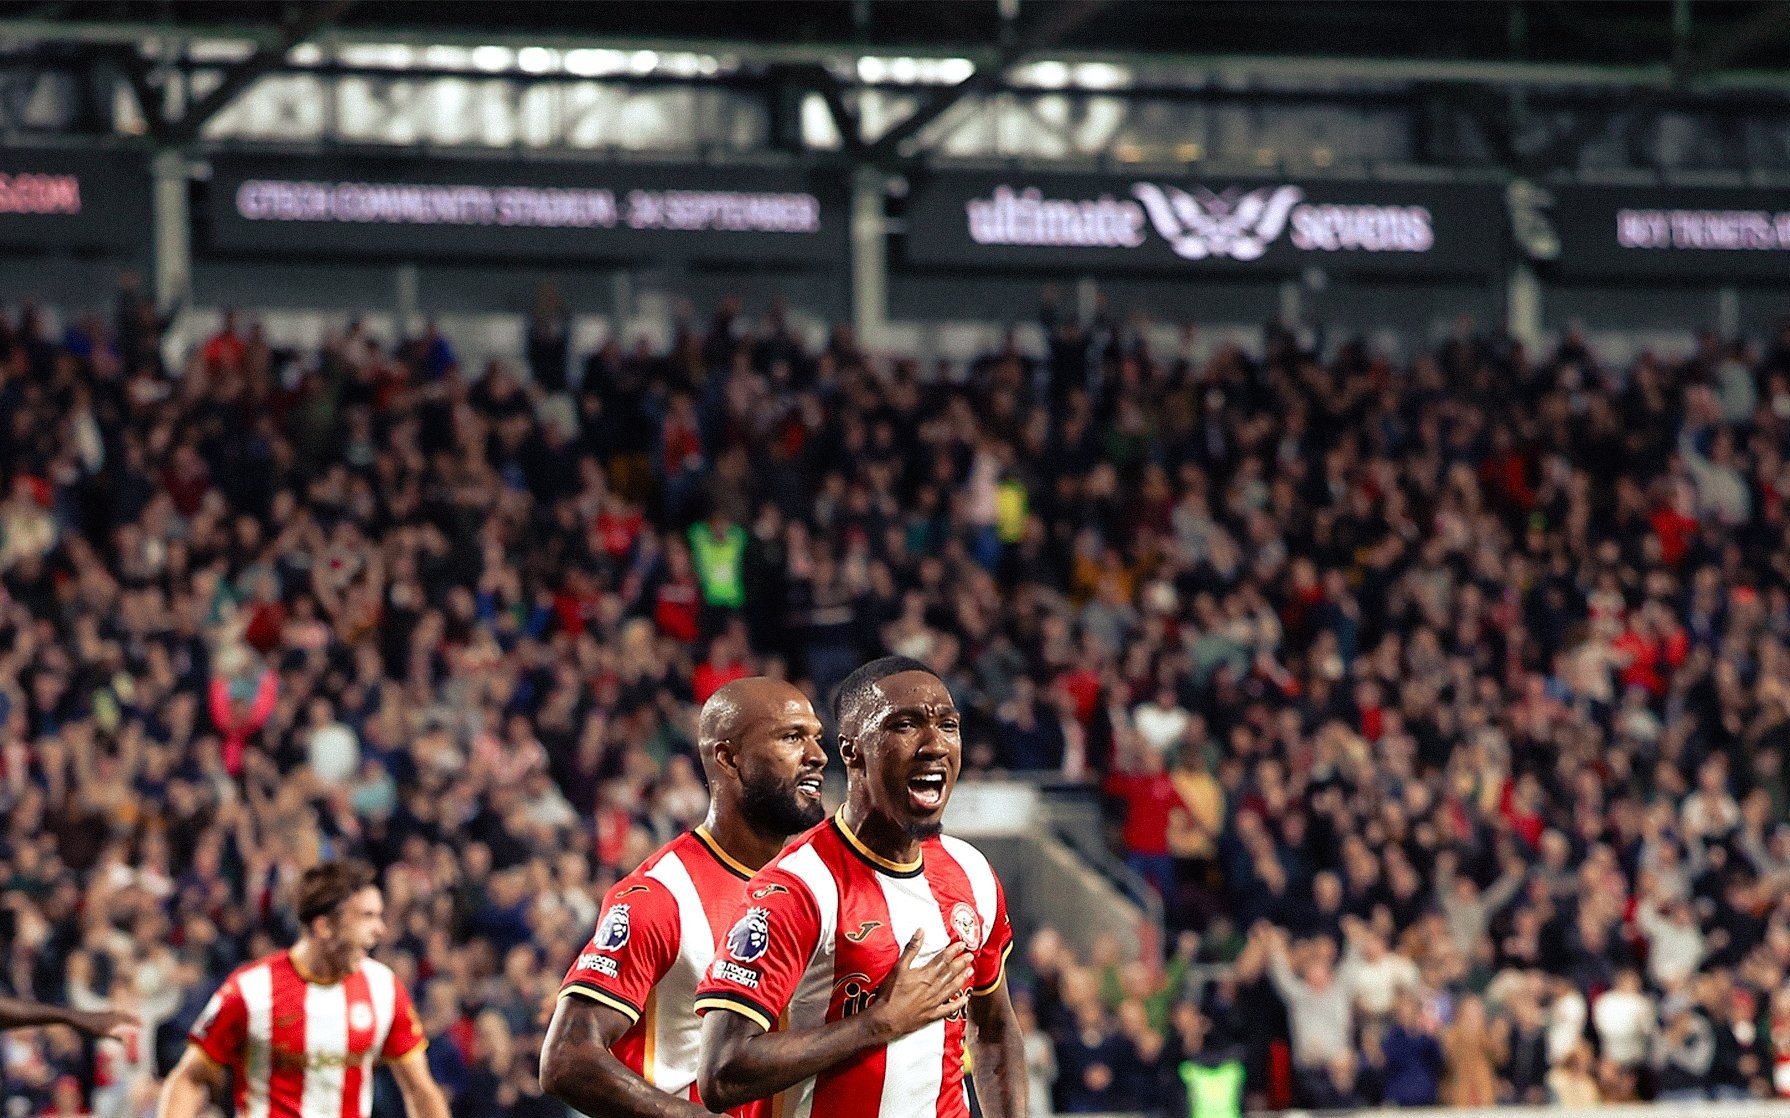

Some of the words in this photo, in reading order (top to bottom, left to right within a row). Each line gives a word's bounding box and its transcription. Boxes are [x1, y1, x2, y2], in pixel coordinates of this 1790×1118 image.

[664, 189, 820, 232] SEPTEMBER
[967, 185, 1145, 247] ultimate
[1291, 202, 1435, 252] sevens
